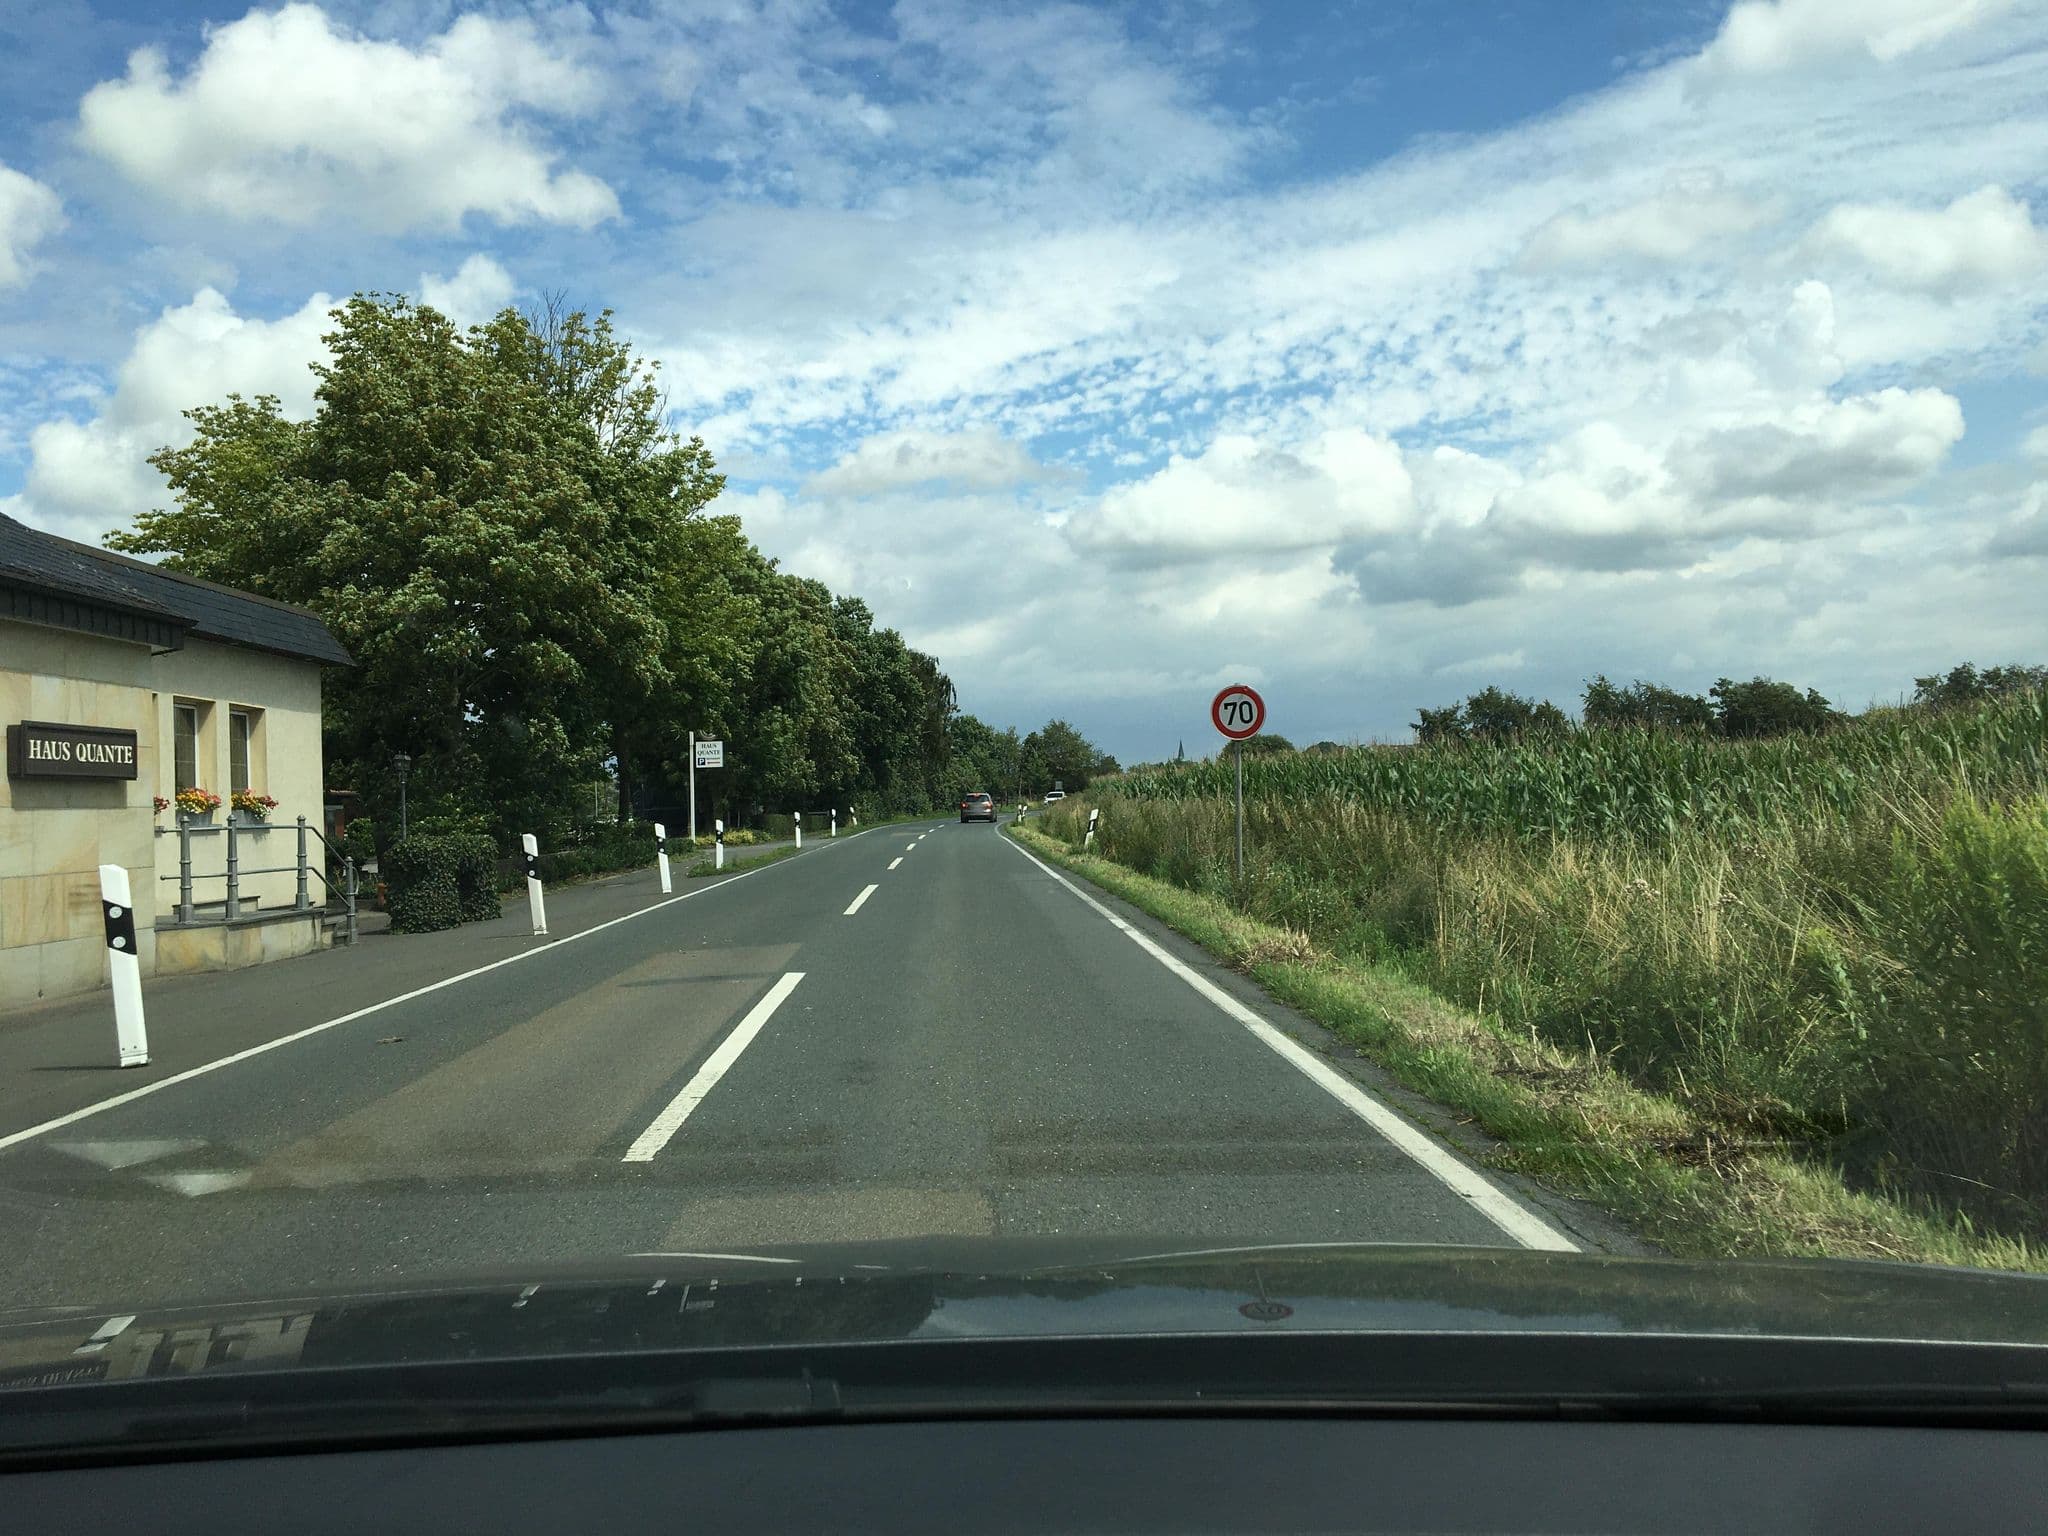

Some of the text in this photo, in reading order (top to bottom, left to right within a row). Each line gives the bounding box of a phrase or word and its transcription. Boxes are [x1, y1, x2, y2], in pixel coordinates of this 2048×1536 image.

[1223, 701, 1253, 725] 70
[29, 739, 133, 764] HAUS QUANTE
